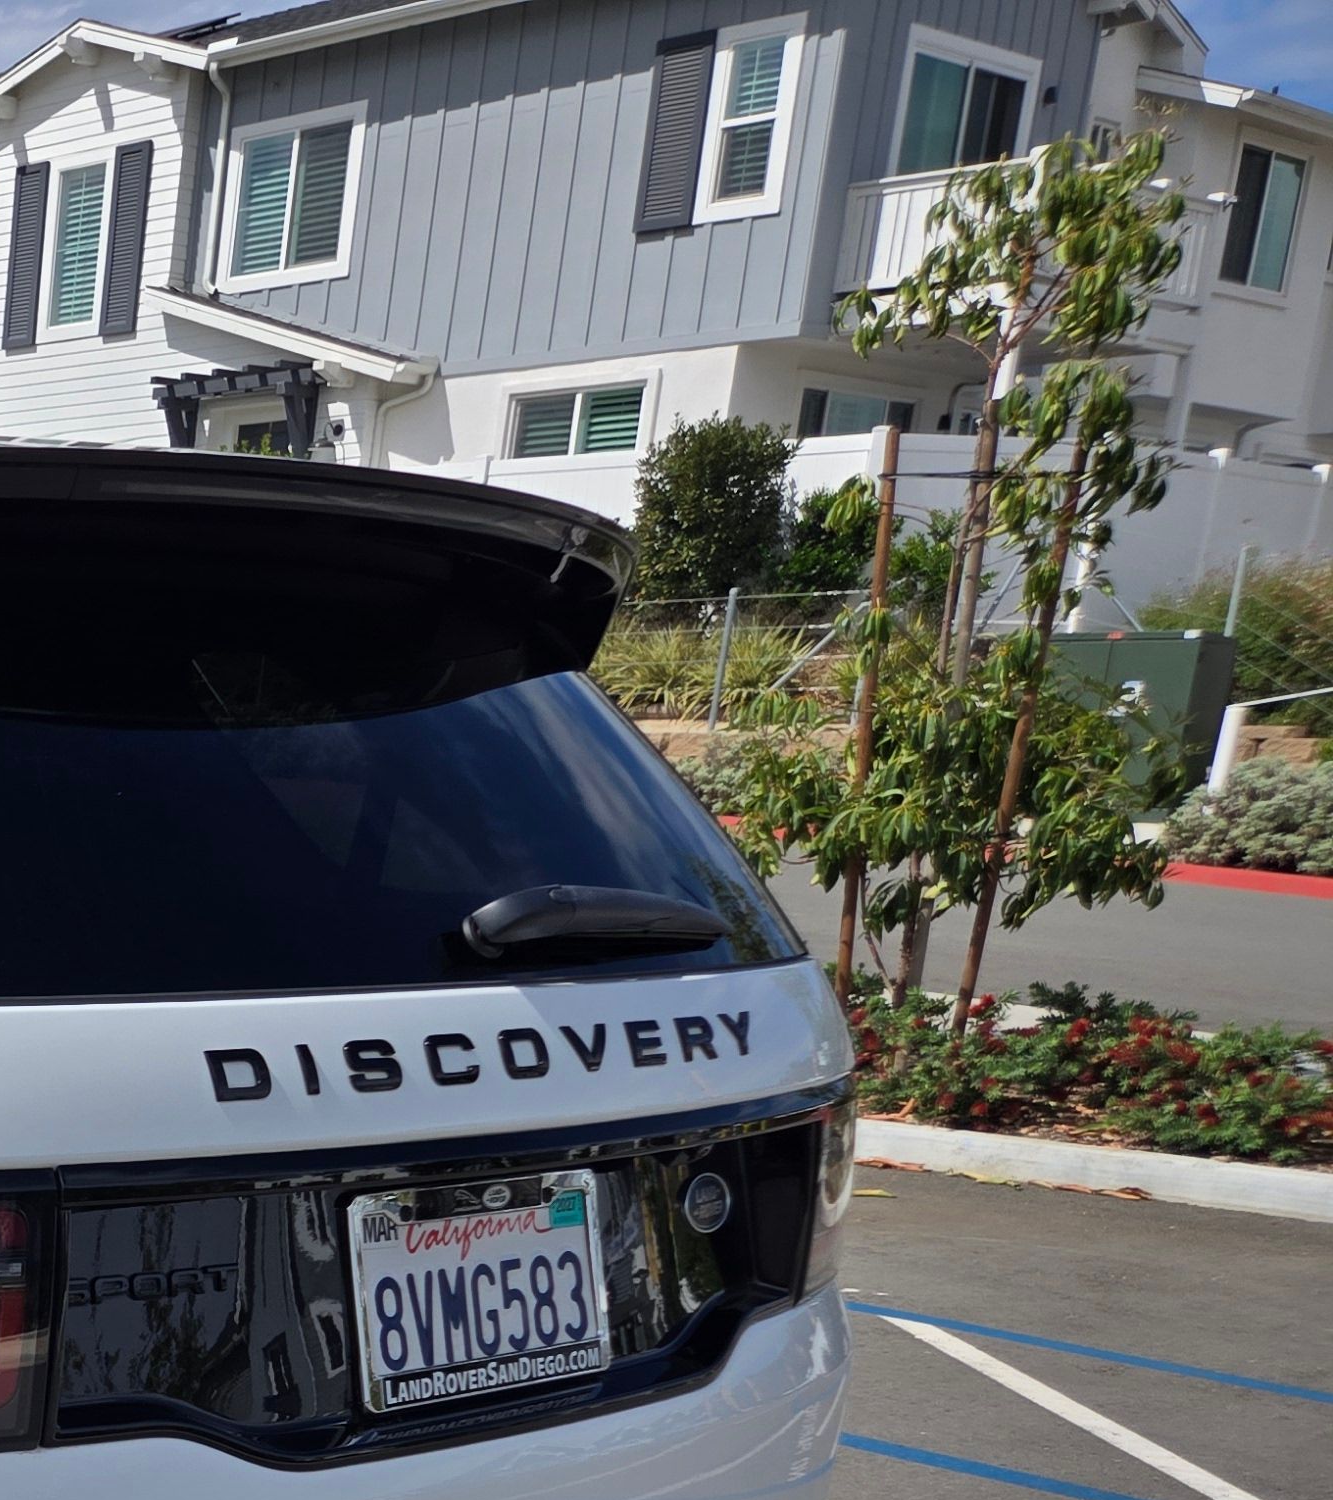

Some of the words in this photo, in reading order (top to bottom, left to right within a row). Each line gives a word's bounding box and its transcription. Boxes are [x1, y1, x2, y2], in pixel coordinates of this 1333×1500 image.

[203, 1010, 752, 1103] DISCOVERY
[362, 1216, 400, 1244] MAR
[405, 1208, 554, 1262] California
[68, 1262, 240, 1308] SPORT
[374, 1250, 589, 1372] 8VMG583
